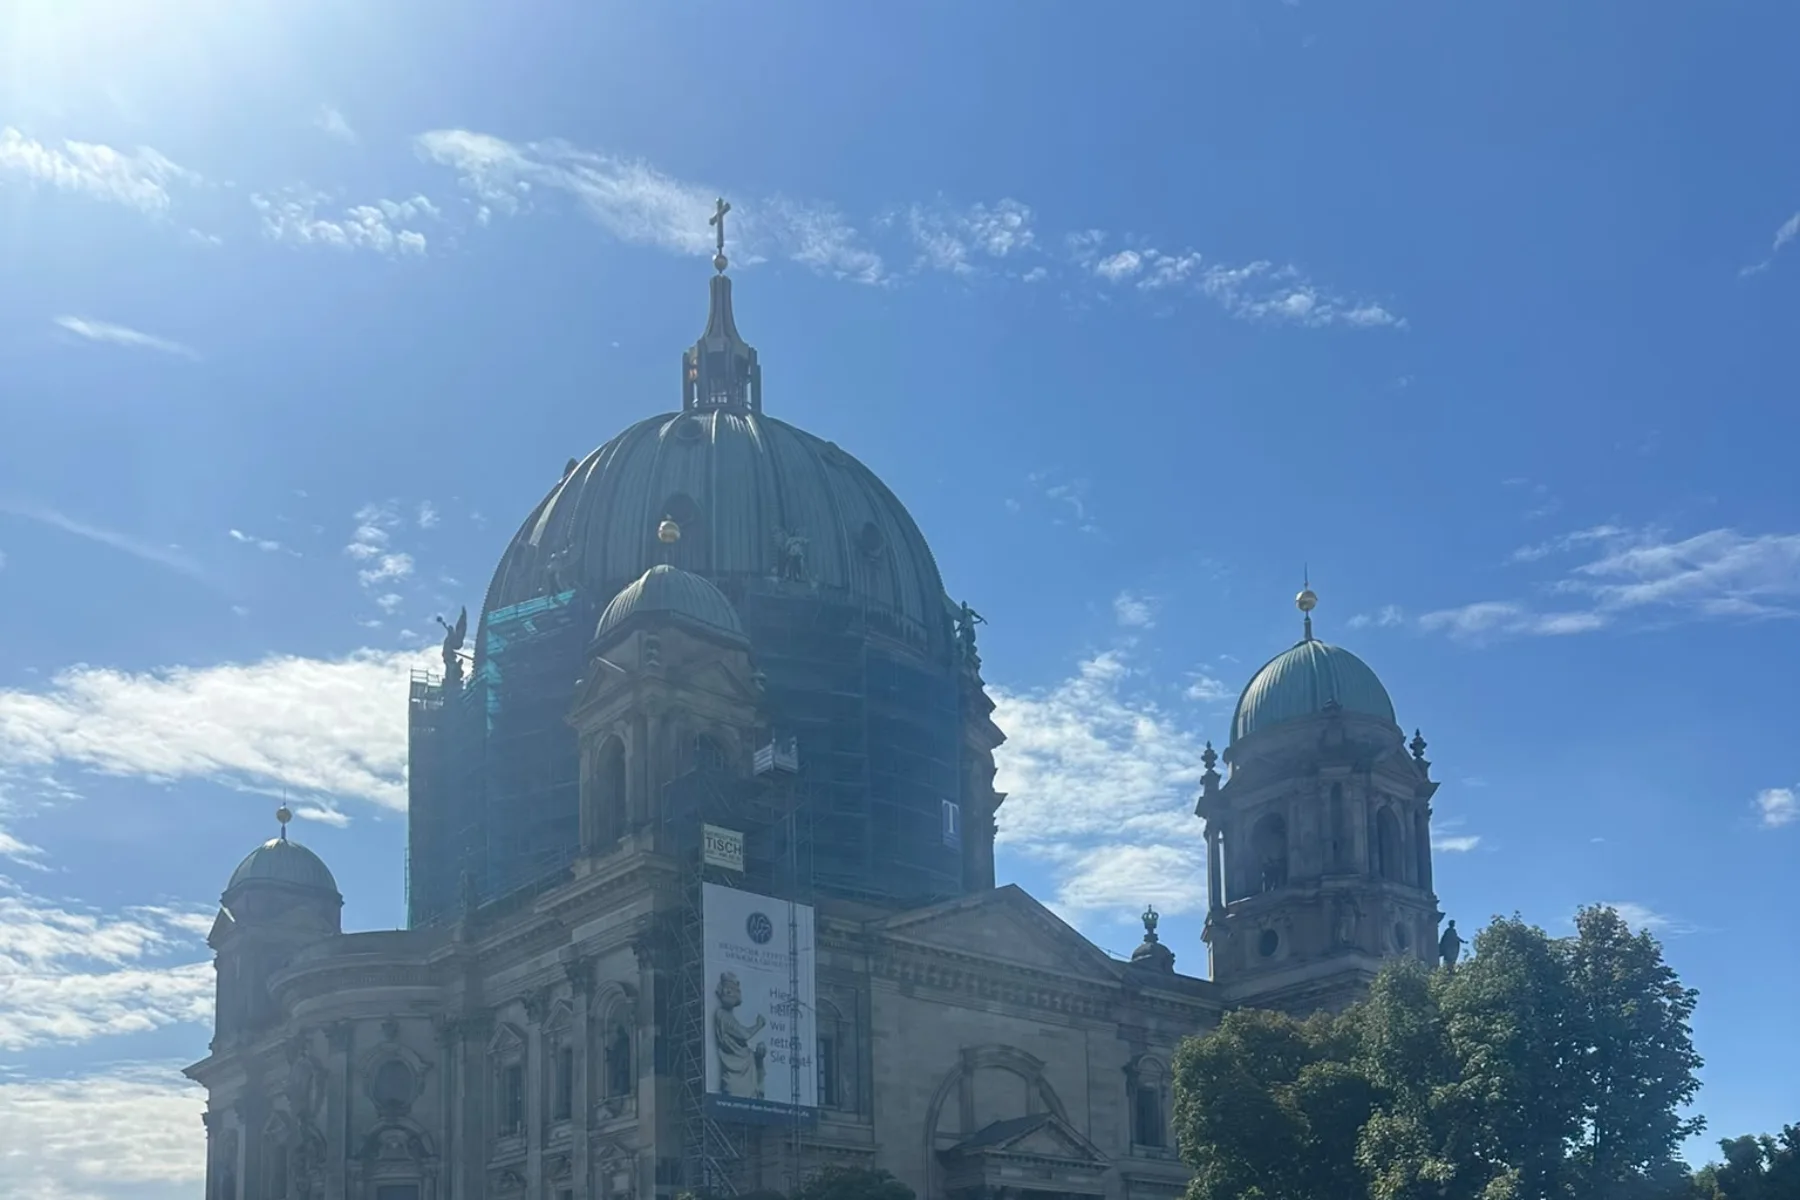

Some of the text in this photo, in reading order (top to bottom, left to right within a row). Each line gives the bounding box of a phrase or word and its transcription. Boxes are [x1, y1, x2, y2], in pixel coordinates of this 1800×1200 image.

[942, 799, 960, 834] T
[705, 836, 742, 856] TISCH
[769, 986, 792, 1000] Hier
[769, 1002, 803, 1018] helfn
[769, 1020, 786, 1032] wir
[769, 1050, 786, 1064] Sie
